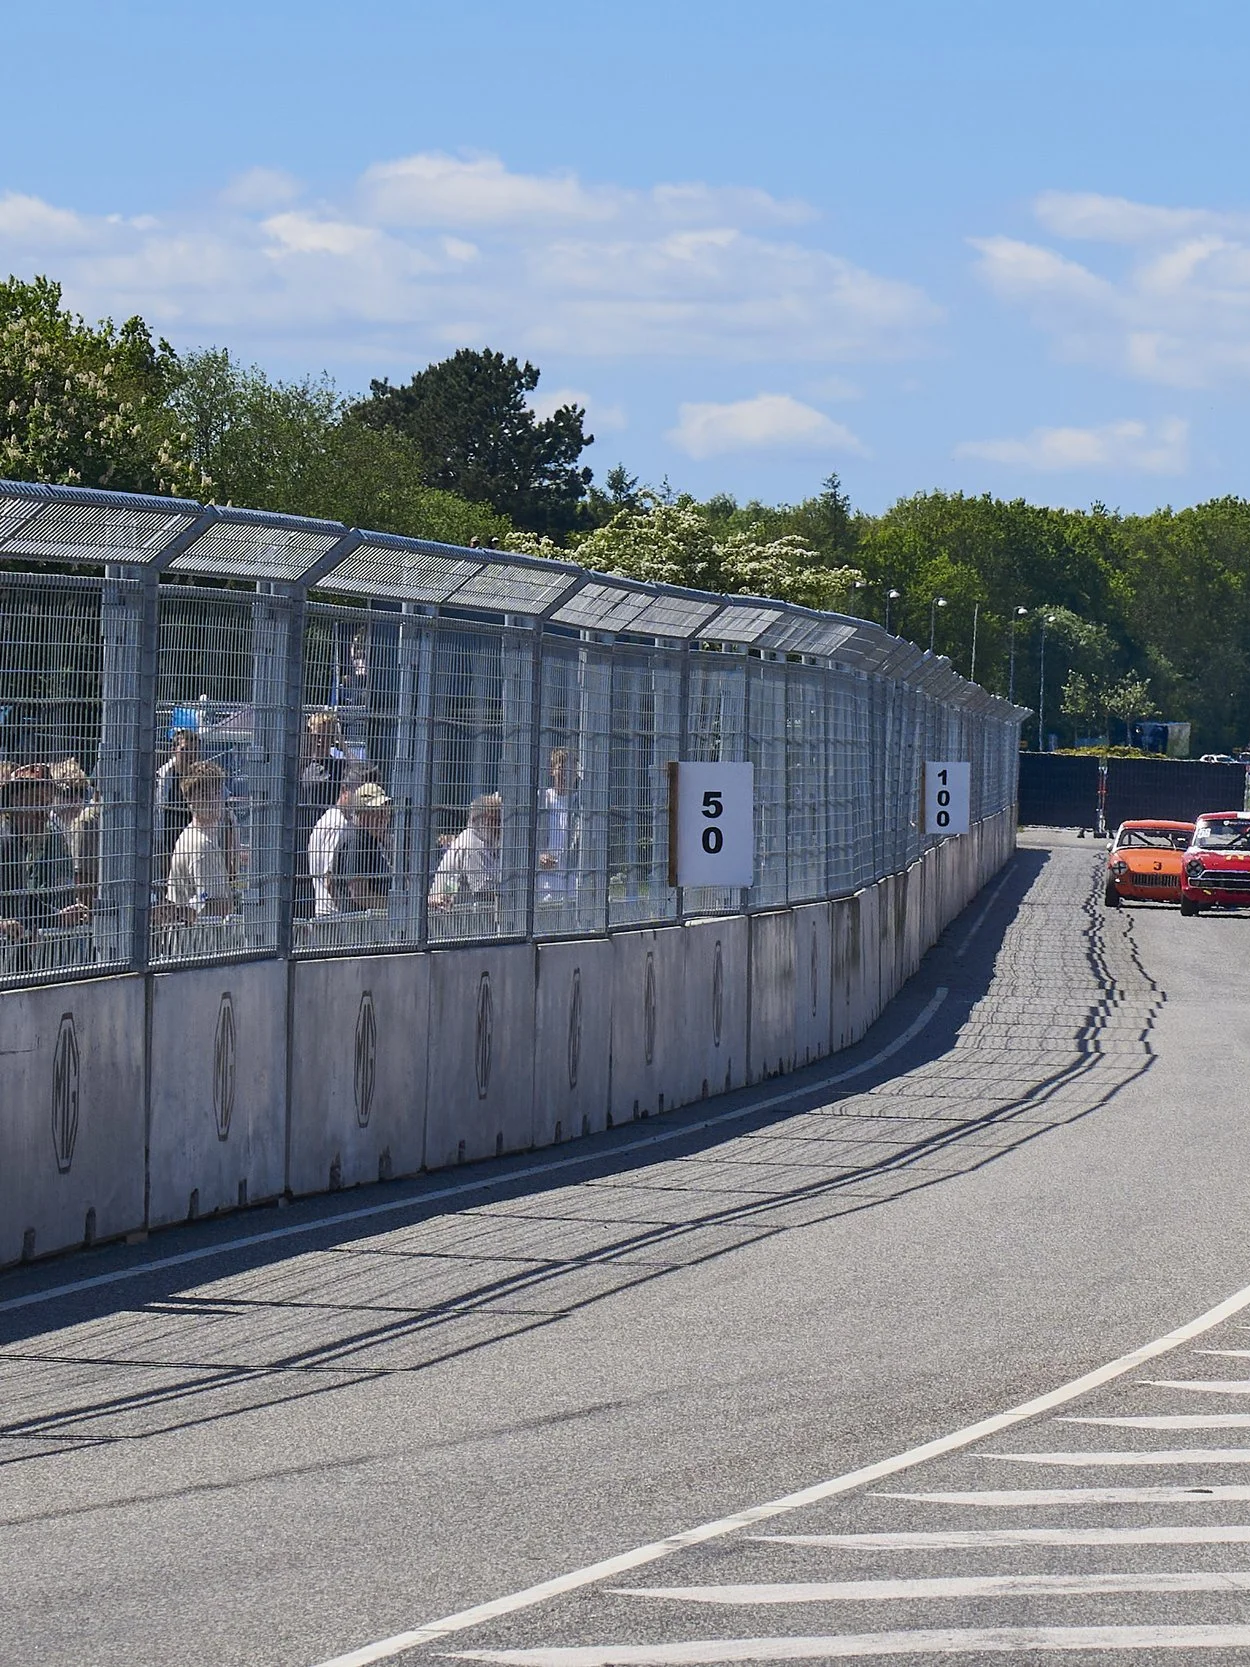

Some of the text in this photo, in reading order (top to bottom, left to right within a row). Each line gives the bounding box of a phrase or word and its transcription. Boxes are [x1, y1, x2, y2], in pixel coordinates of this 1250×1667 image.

[701, 791, 724, 854] 50
[936, 769, 950, 827] 100
[1153, 861, 1162, 871] 3
